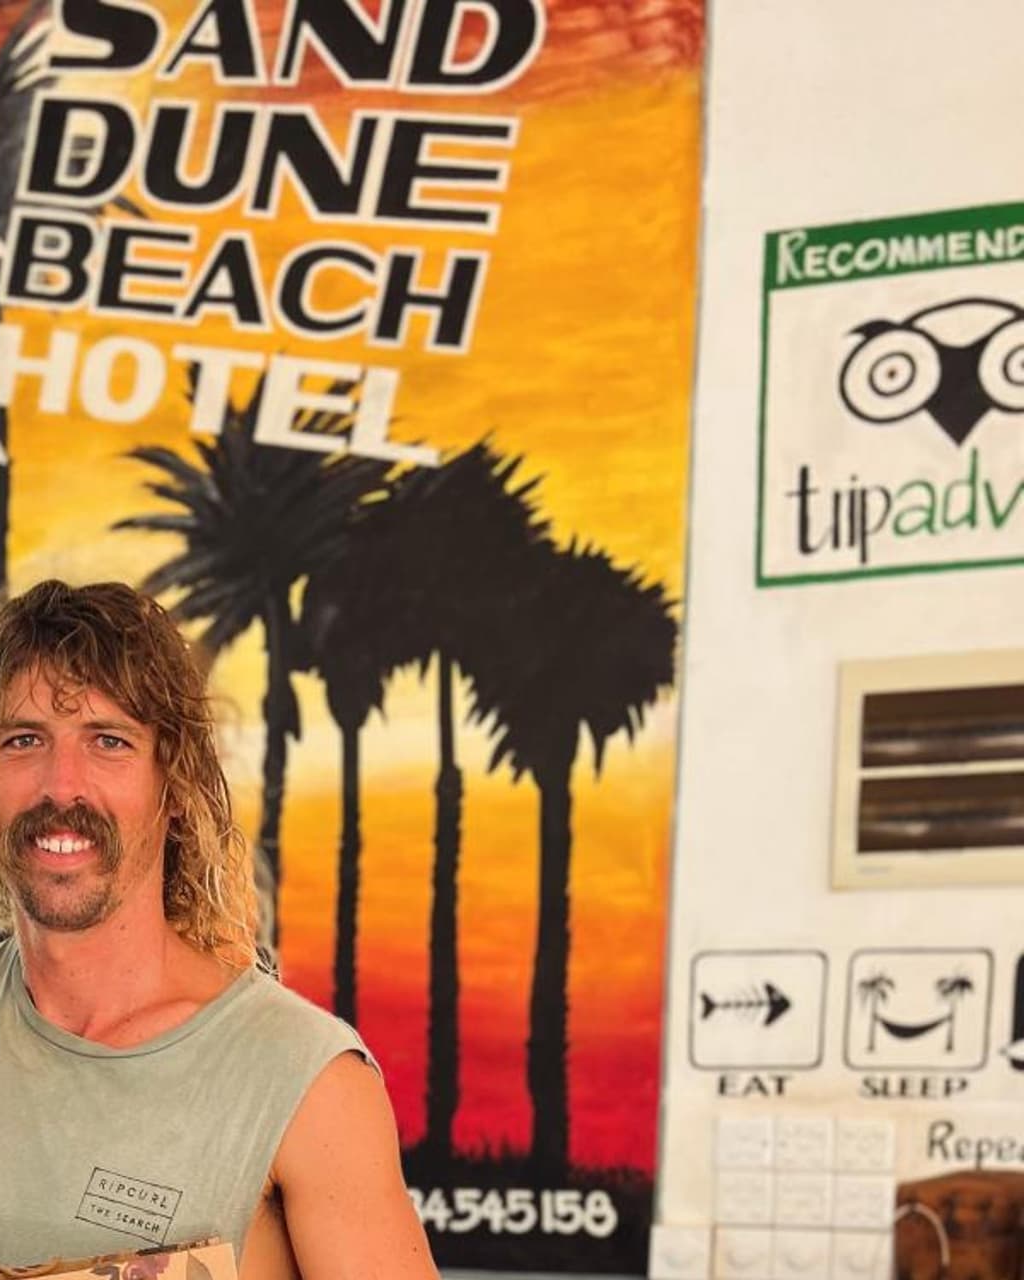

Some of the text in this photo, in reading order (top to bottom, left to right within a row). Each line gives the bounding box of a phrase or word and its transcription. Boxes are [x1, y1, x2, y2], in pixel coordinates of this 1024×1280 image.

[46, 0, 547, 93] SAND
[15, 89, 520, 235] DUNE
[718, 1073, 794, 1097] EAT
[862, 1075, 970, 1099] SLEEP
[927, 1119, 1024, 1169] Repe
[90, 1204, 160, 1233] THE SEARCH
